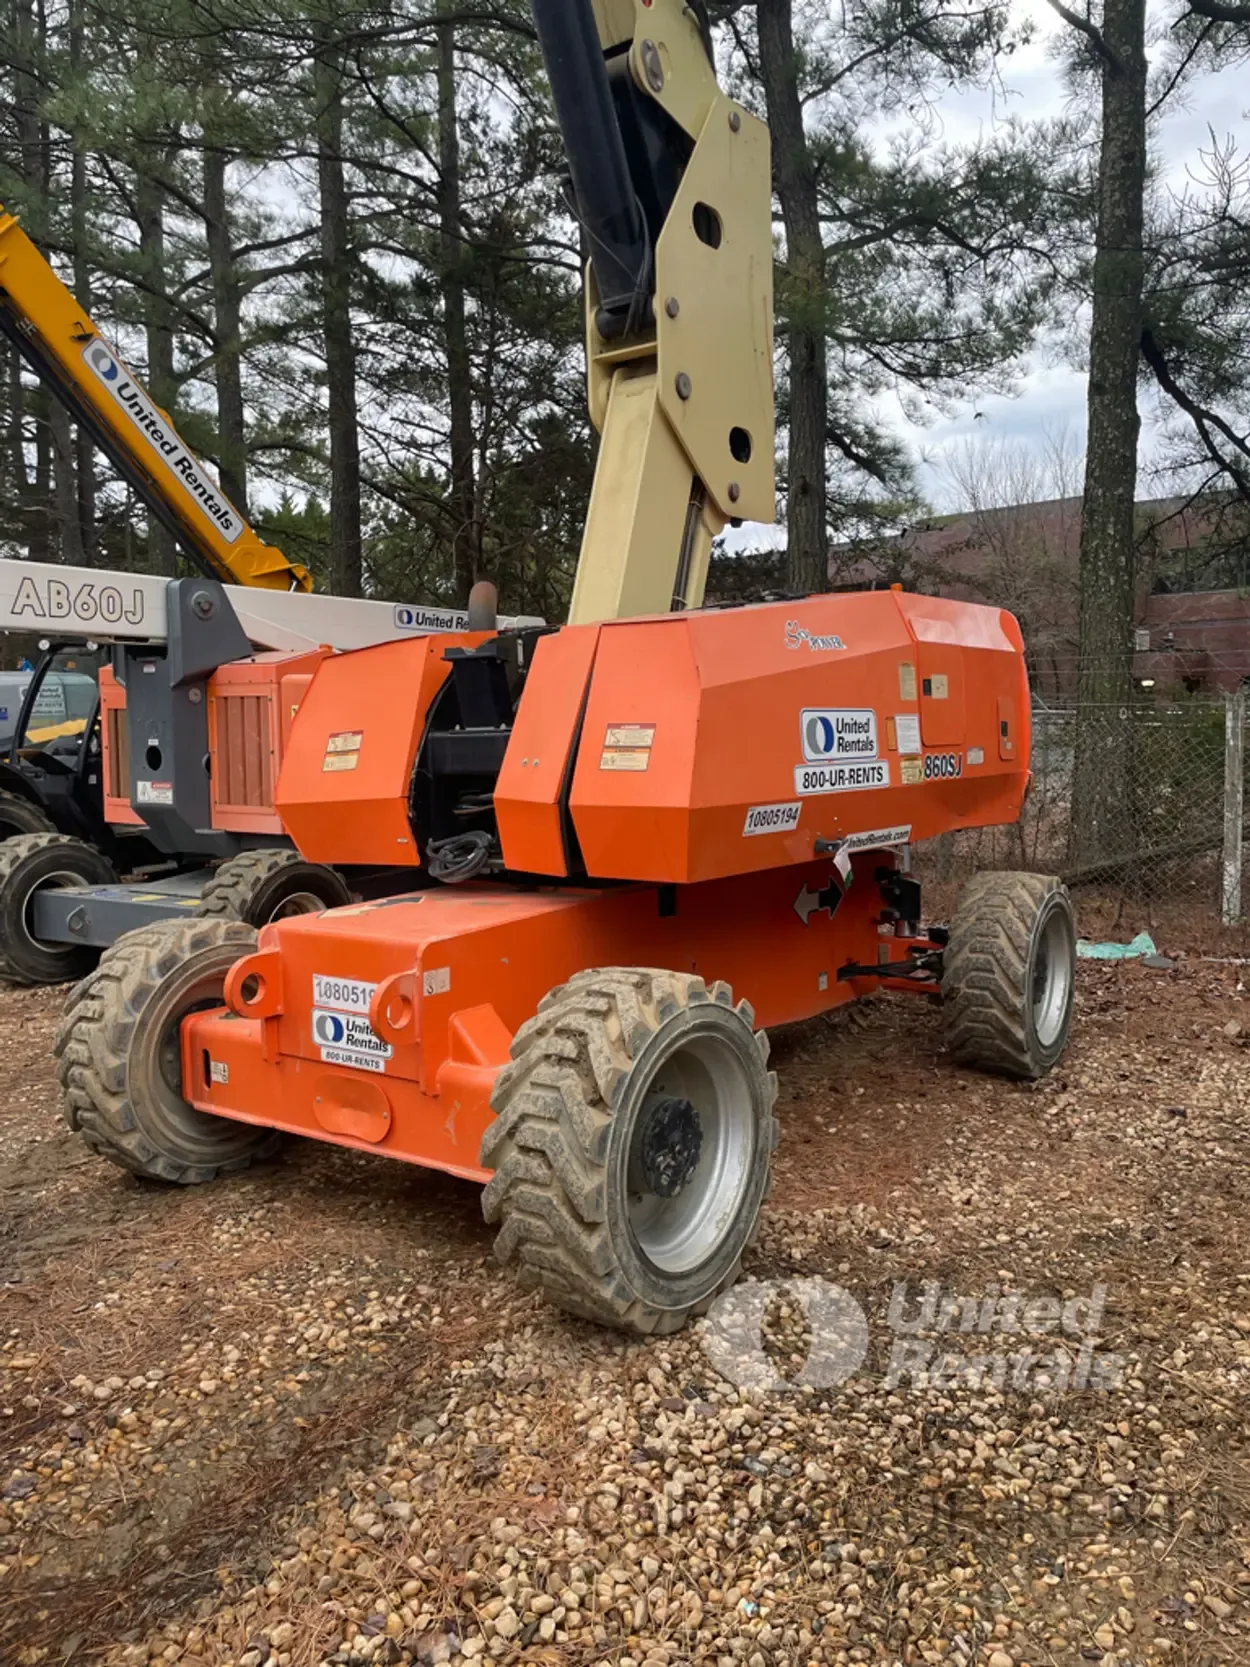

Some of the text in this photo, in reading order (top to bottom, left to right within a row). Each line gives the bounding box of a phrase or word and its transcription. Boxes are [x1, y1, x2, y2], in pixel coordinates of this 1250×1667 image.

[116, 382, 233, 530] United Rentals
[10, 576, 145, 625] AB60J
[415, 612, 453, 629] United
[836, 717, 870, 734] United
[837, 735, 875, 753] Rentals
[923, 753, 963, 780] 860SJ
[802, 766, 884, 789] 800-UR-RENTS
[748, 806, 800, 828] 10805194
[346, 1033, 388, 1052] Rentals
[325, 1050, 381, 1070] 800-UR-RENTS
